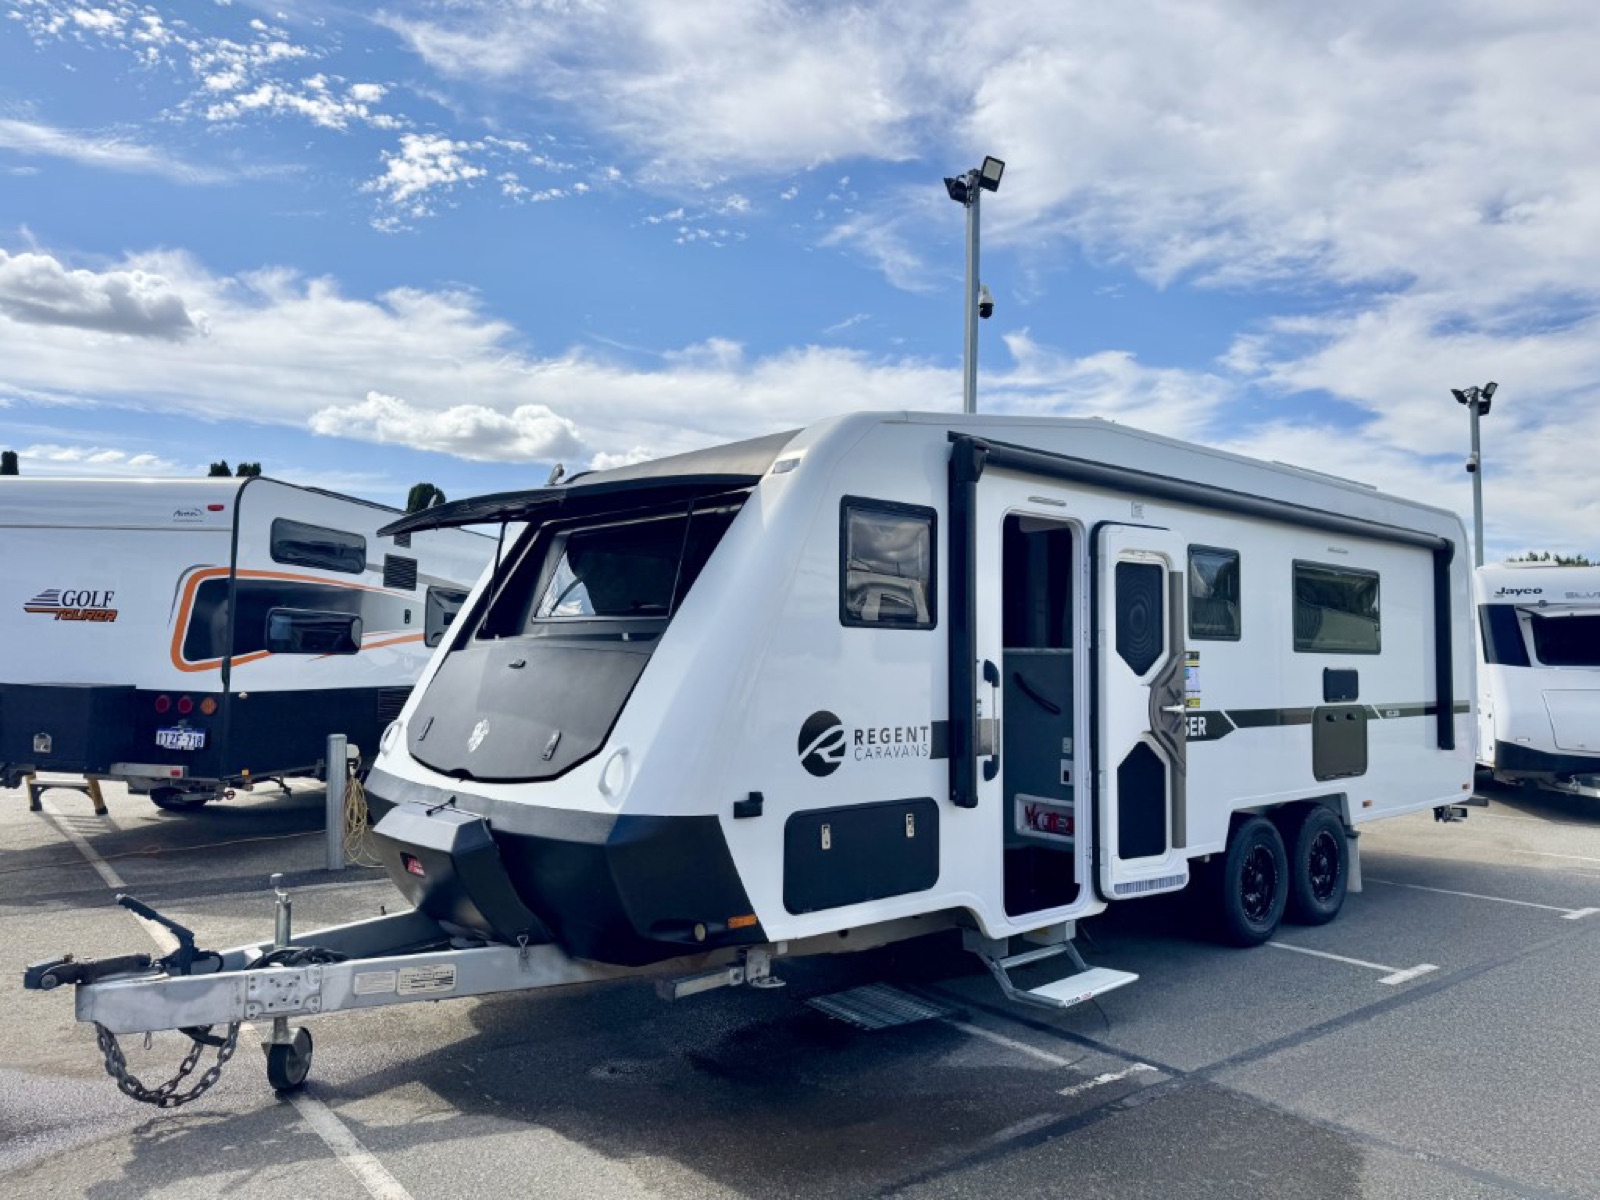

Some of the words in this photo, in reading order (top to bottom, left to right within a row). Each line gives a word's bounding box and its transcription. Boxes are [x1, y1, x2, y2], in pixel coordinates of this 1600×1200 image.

[61, 590, 115, 608] GOLF
[1495, 587, 1543, 596] Jayco
[54, 608, 118, 622] TOURER
[853, 725, 929, 746] REGENT
[853, 743, 929, 762] CARAVANS
